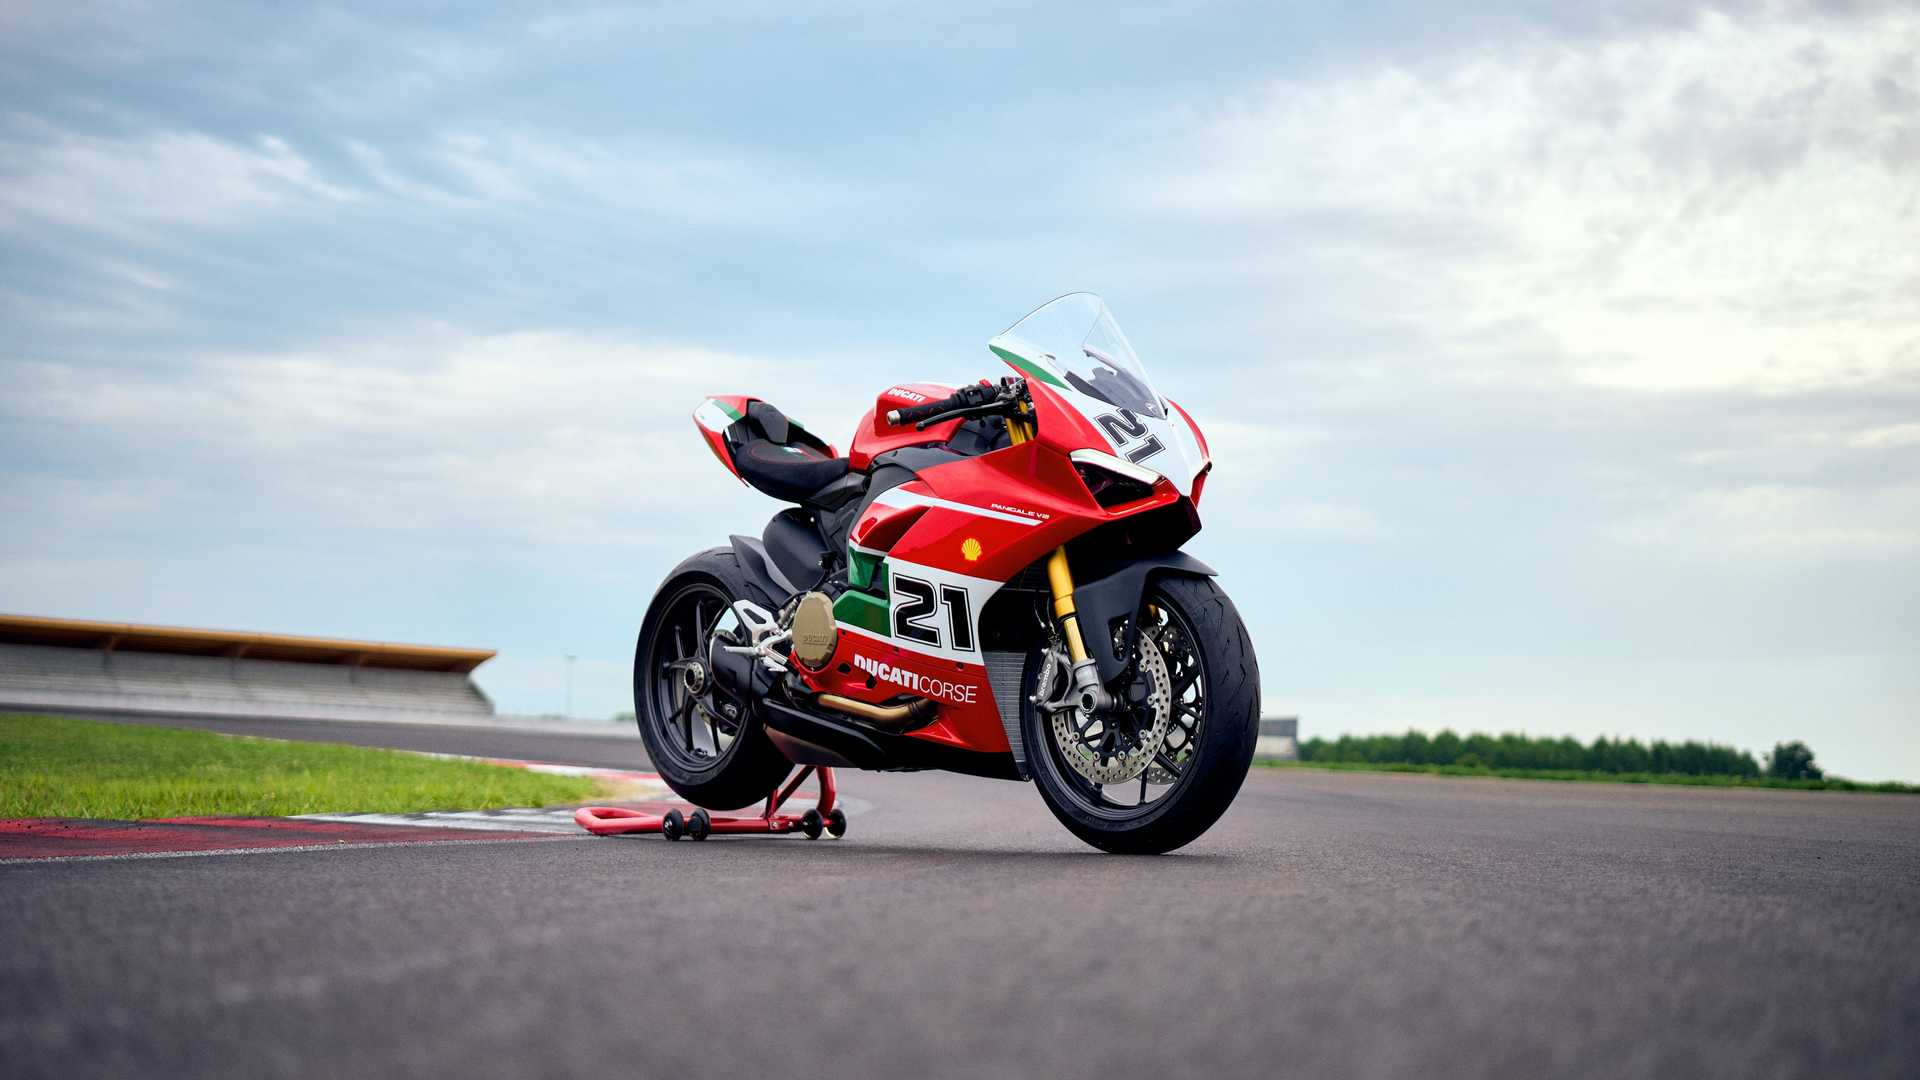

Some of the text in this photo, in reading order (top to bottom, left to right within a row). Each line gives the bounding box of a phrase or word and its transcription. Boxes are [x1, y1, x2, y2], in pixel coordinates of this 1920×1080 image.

[887, 387, 926, 402] DUCATI
[1094, 407, 1166, 465] 21
[893, 572, 975, 652] 21
